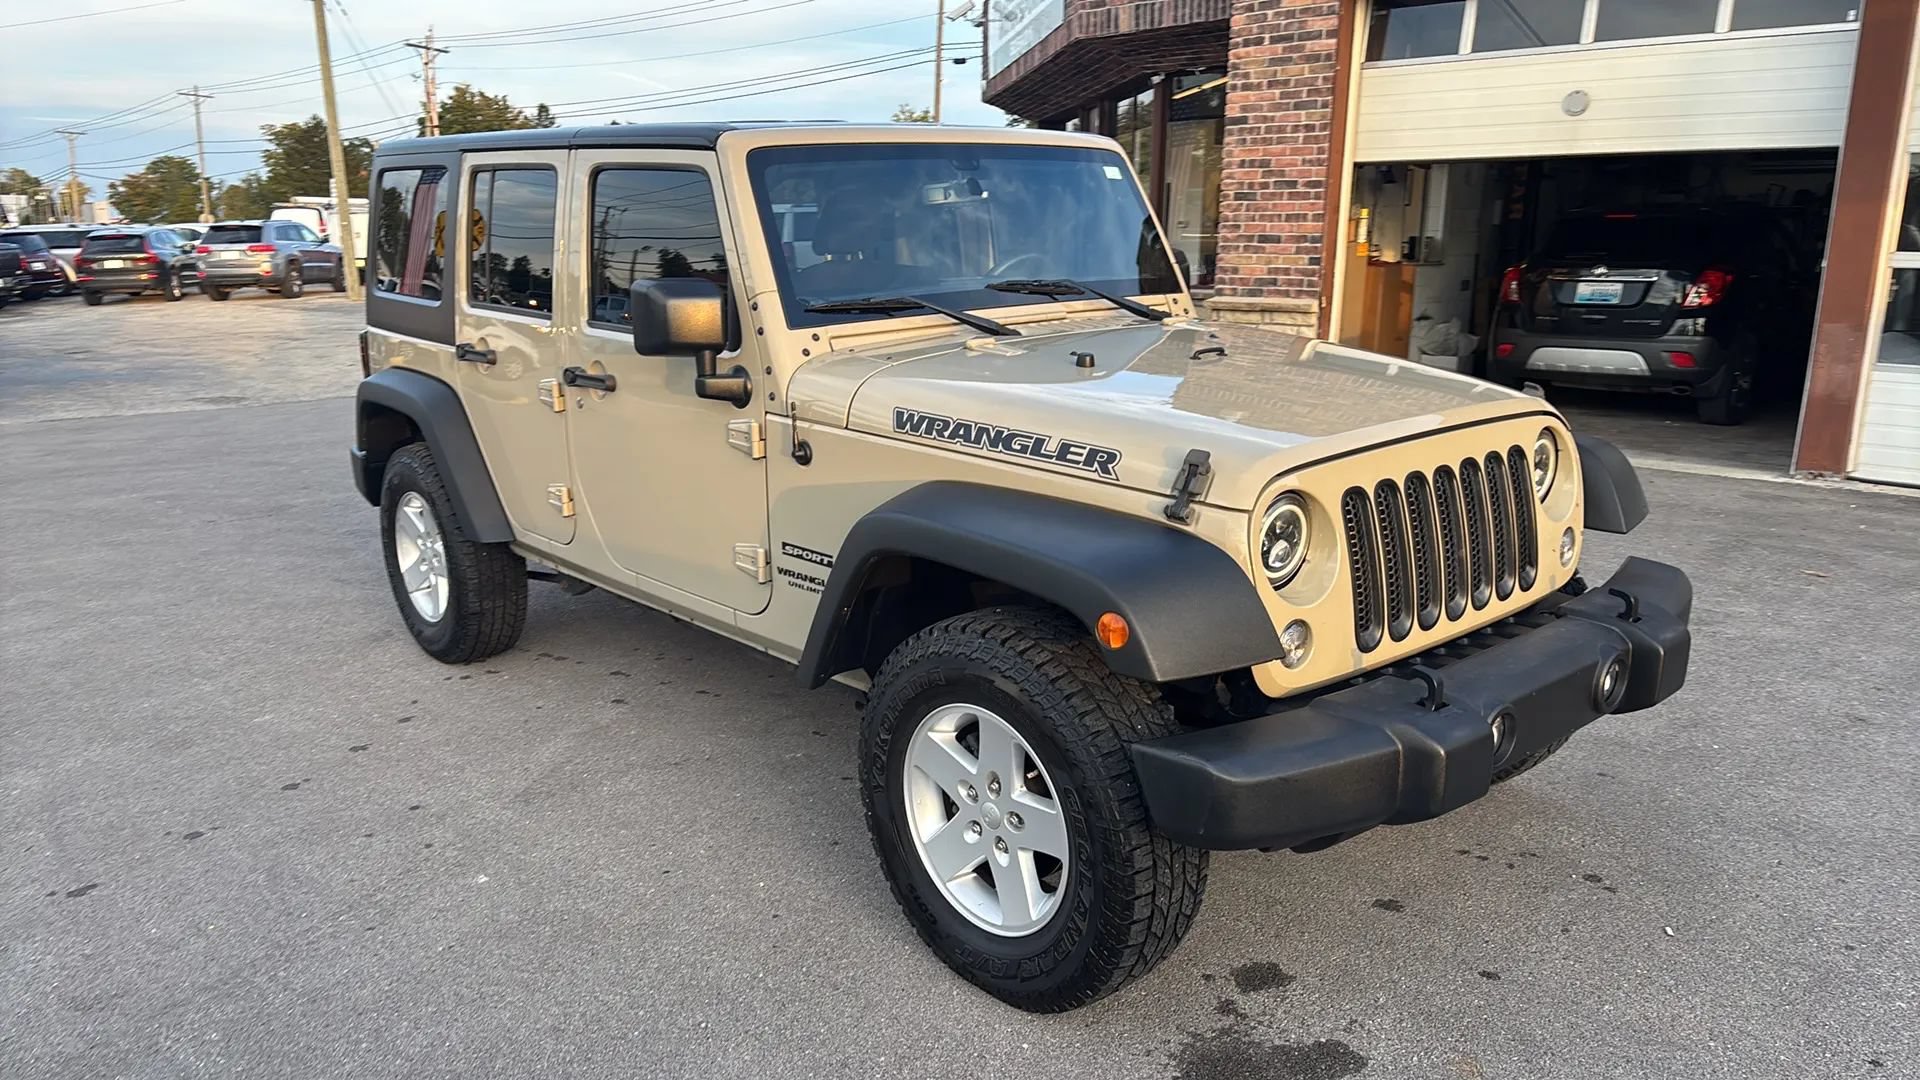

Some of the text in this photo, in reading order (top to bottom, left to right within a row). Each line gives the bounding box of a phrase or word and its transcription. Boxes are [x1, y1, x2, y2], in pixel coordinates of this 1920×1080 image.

[893, 407, 1122, 481] WRANGLER
[782, 542, 833, 568] SPORT
[777, 566, 825, 587] WRANGL
